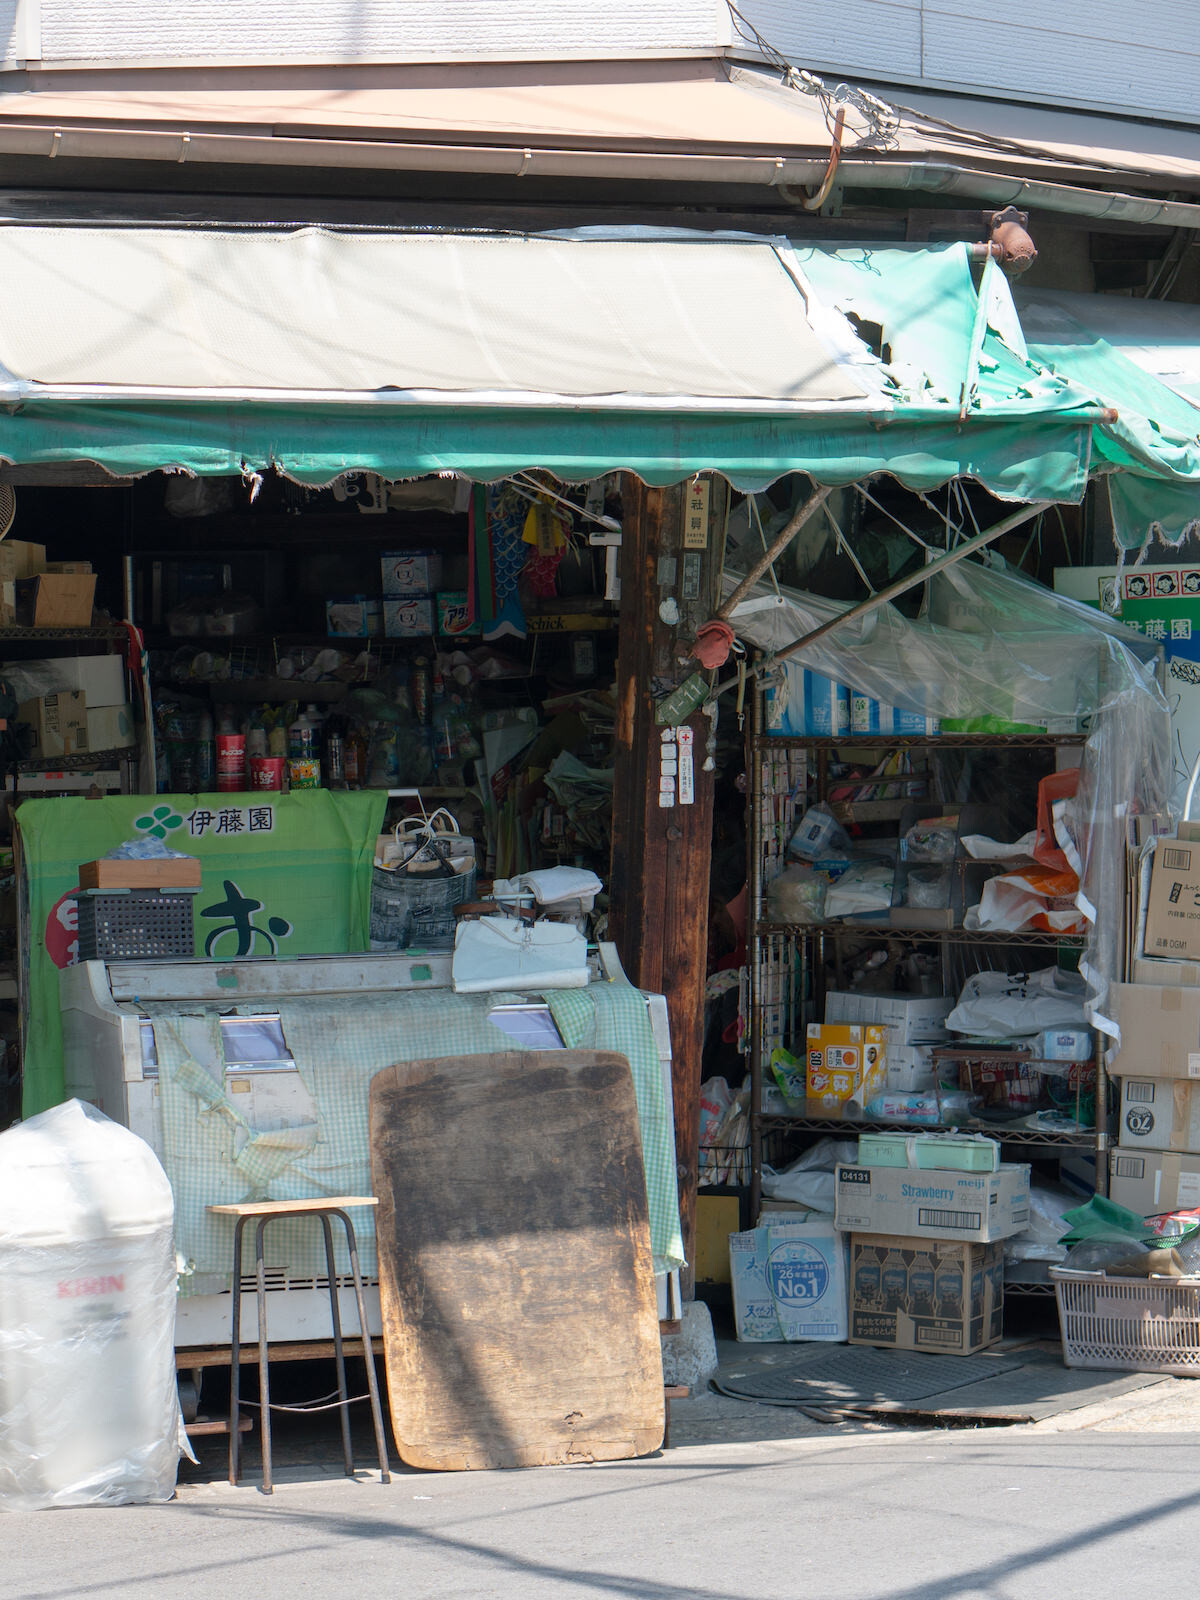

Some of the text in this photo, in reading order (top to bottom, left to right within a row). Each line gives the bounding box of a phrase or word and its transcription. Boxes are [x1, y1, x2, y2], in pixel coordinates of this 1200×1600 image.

[187, 806, 274, 835] 伊藤園
[841, 1171, 869, 1182] 04131
[957, 1178, 985, 1190] meiji
[901, 1183, 954, 1201] Strawberry
[777, 1279, 819, 1298] No.1
